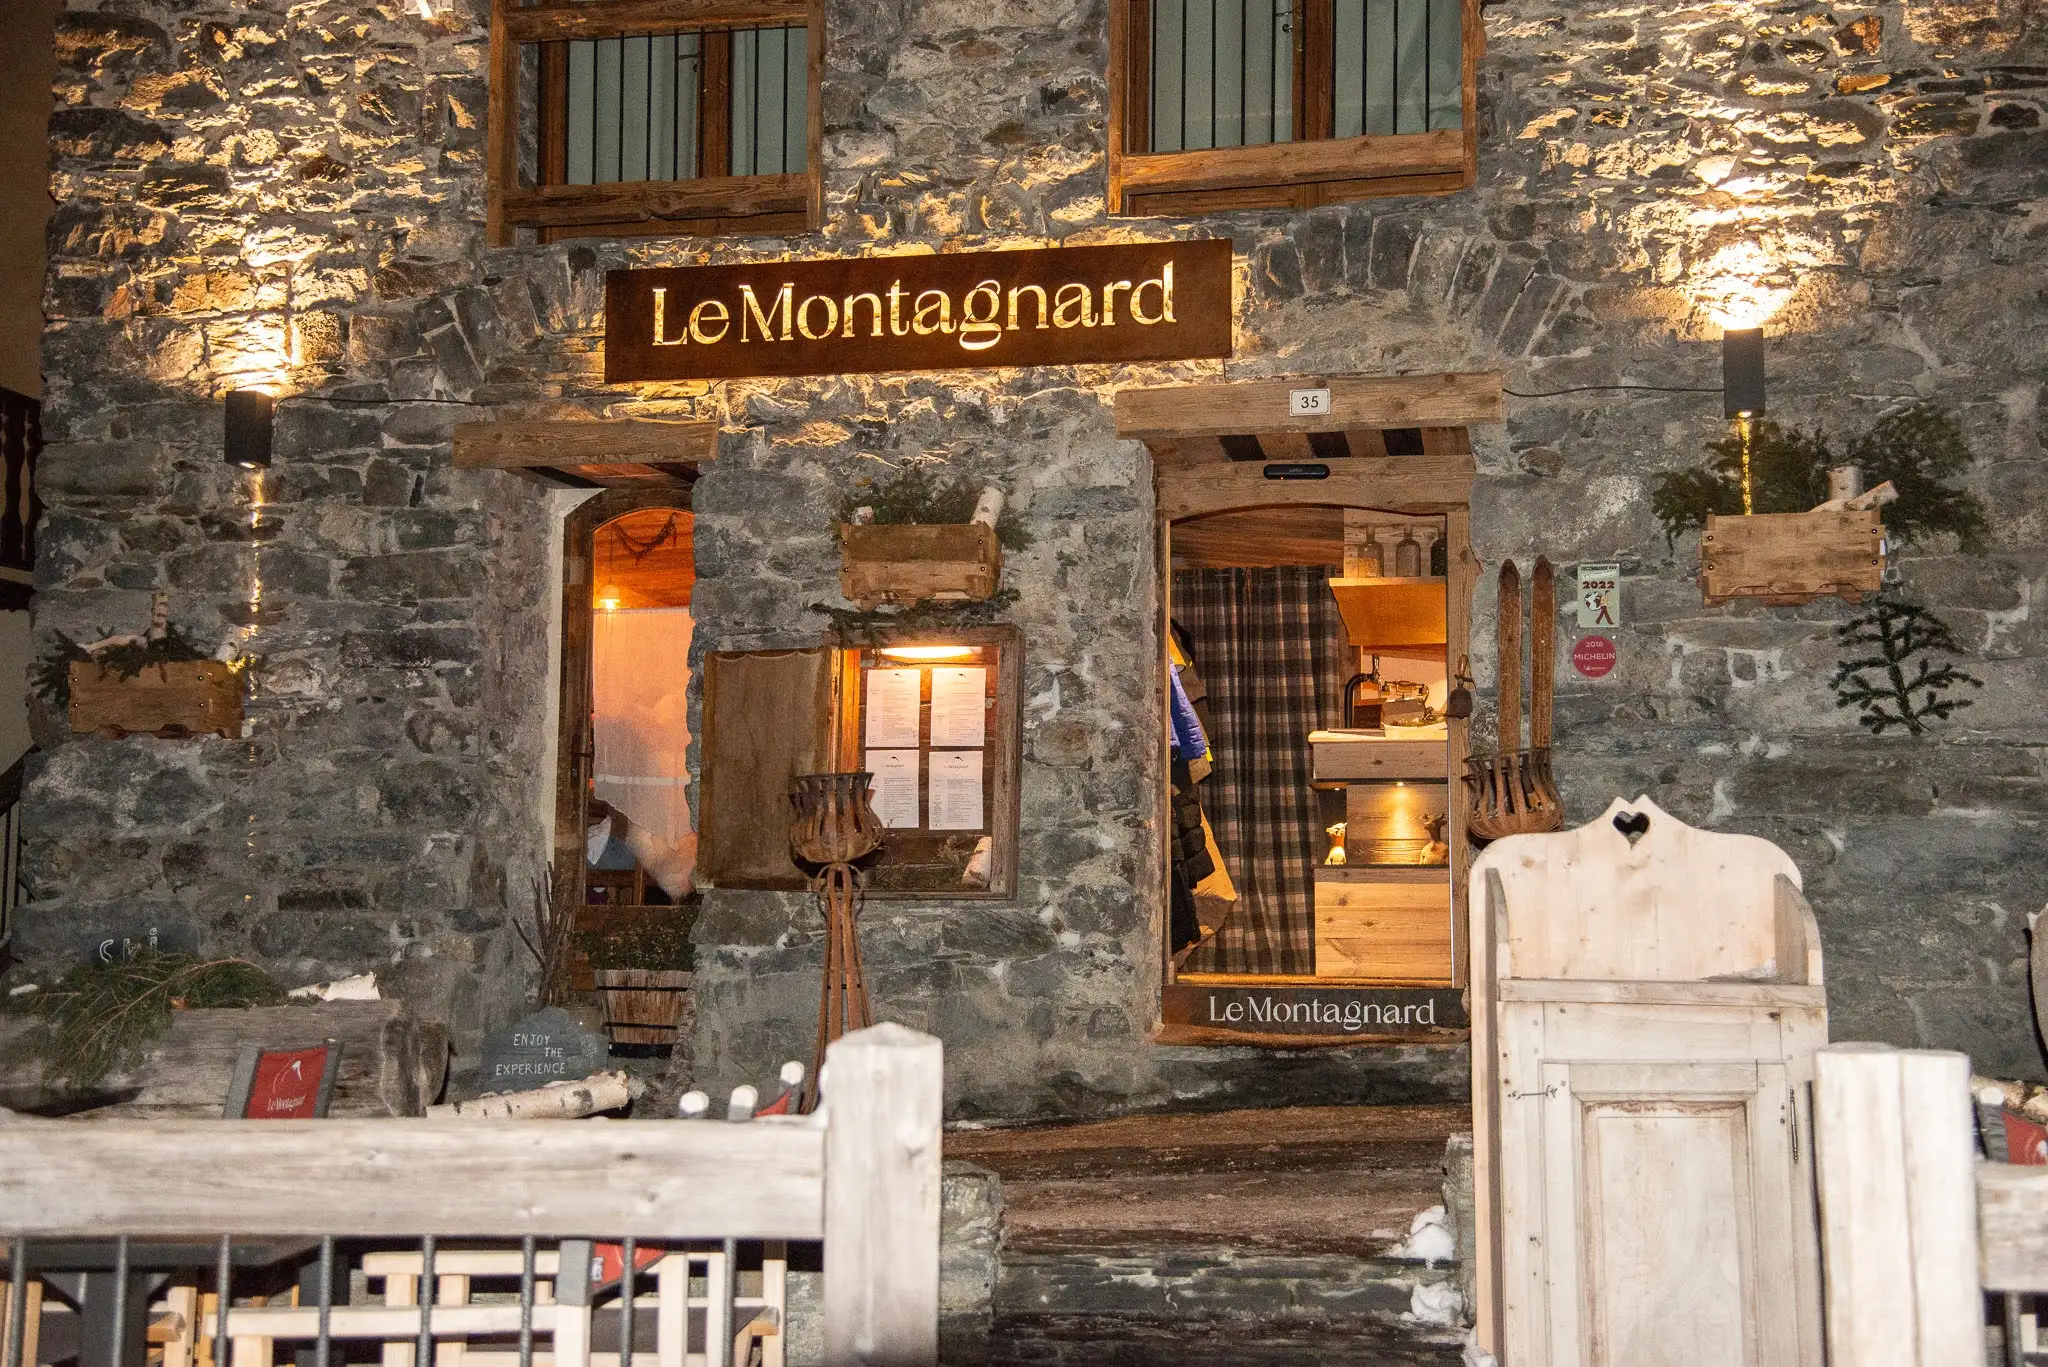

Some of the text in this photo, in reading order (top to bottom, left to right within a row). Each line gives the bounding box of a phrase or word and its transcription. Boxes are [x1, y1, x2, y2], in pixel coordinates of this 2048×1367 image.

[652, 260, 1177, 351] Le Montagnard
[1301, 396, 1319, 409] 35
[1582, 580, 1615, 589] 2022
[1209, 996, 1436, 1031] Le Montagnard
[513, 1033, 550, 1046] ENJOY
[544, 1047, 563, 1058] THE
